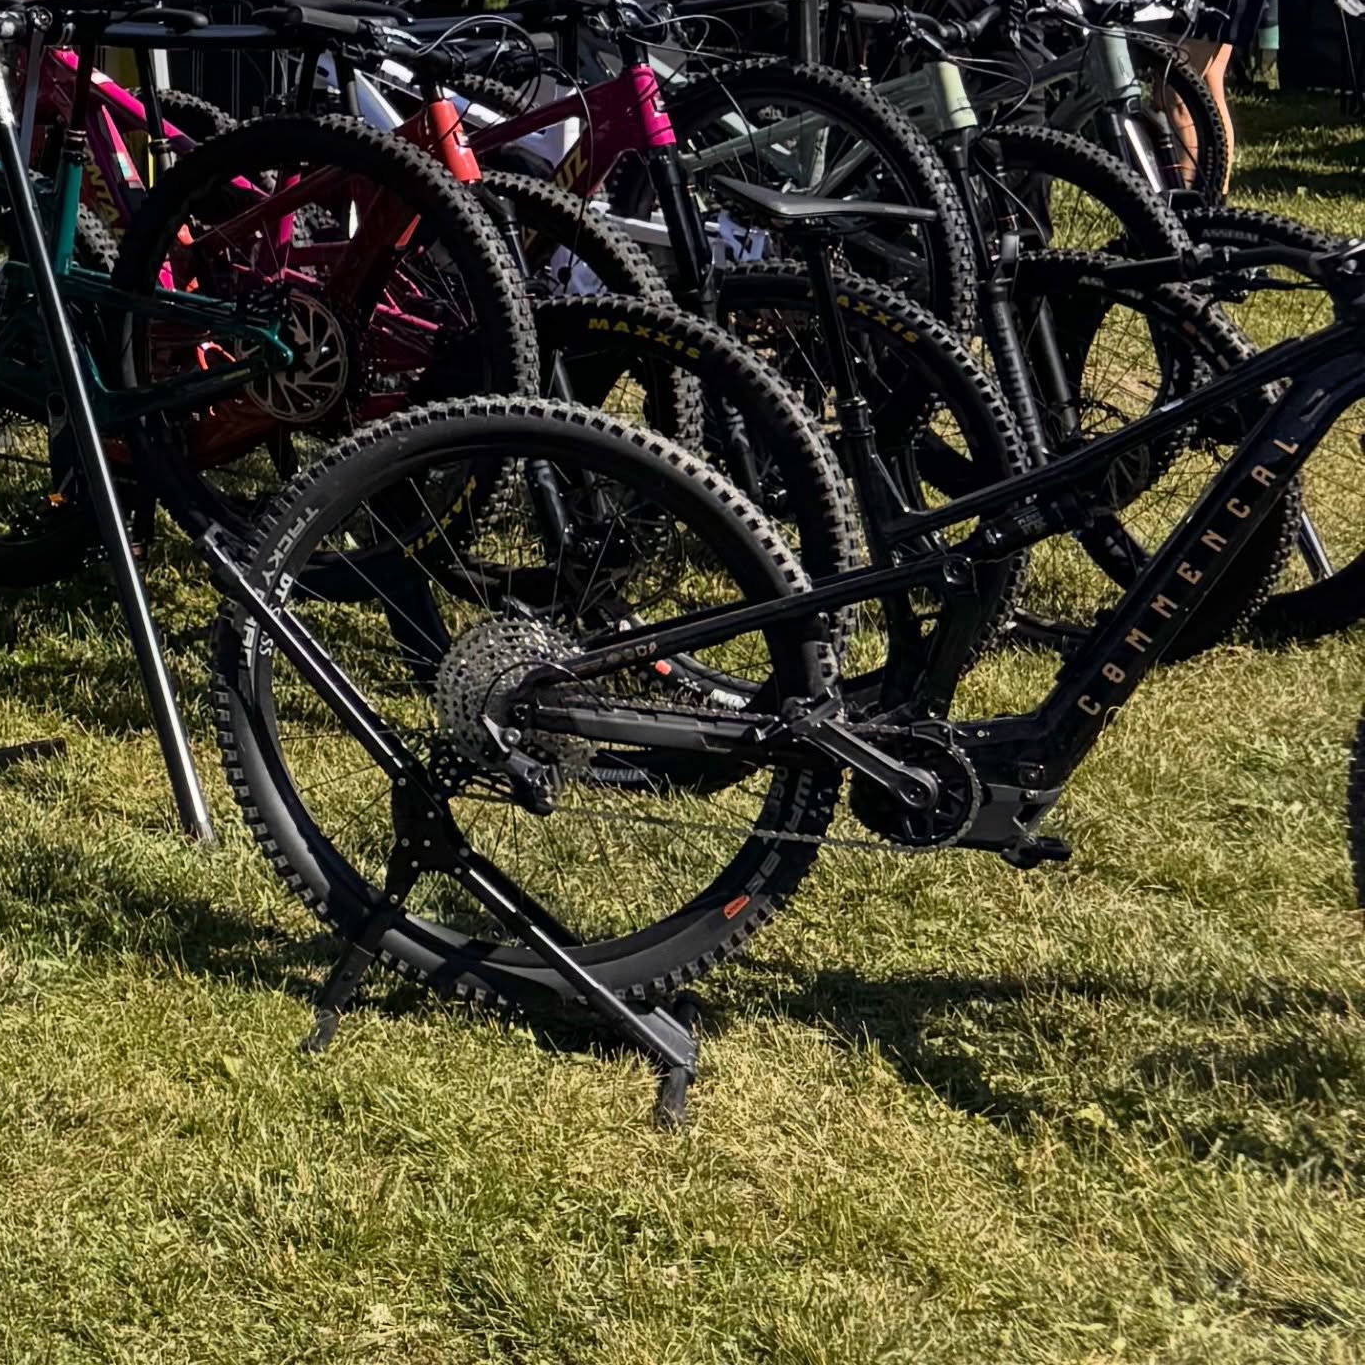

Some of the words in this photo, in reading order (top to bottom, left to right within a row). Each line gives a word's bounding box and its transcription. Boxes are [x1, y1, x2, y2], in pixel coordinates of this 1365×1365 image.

[588, 318, 701, 360] MAXXIS
[809, 290, 919, 344] AXXIS
[262, 506, 319, 587] TACKY
